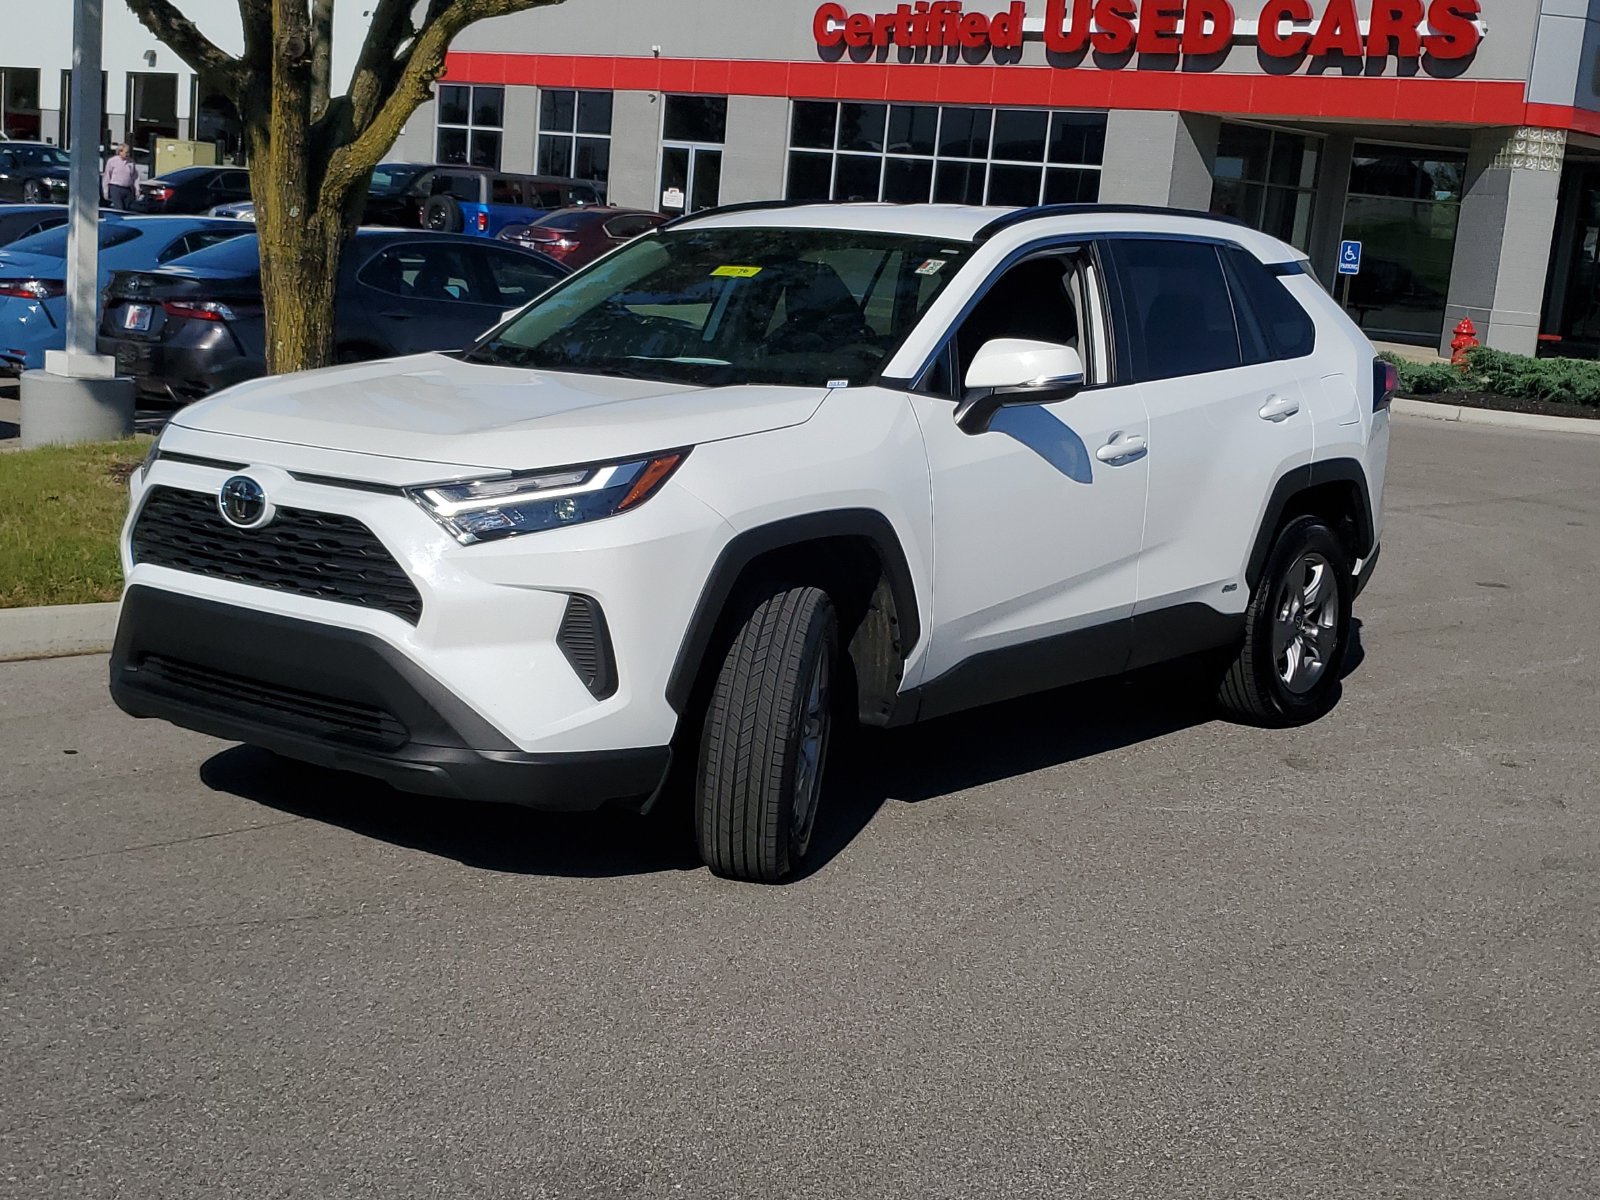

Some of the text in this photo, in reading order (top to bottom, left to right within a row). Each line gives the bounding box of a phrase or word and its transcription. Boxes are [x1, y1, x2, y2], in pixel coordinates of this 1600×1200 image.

[813, 0, 1482, 60] Certified USED CARS
